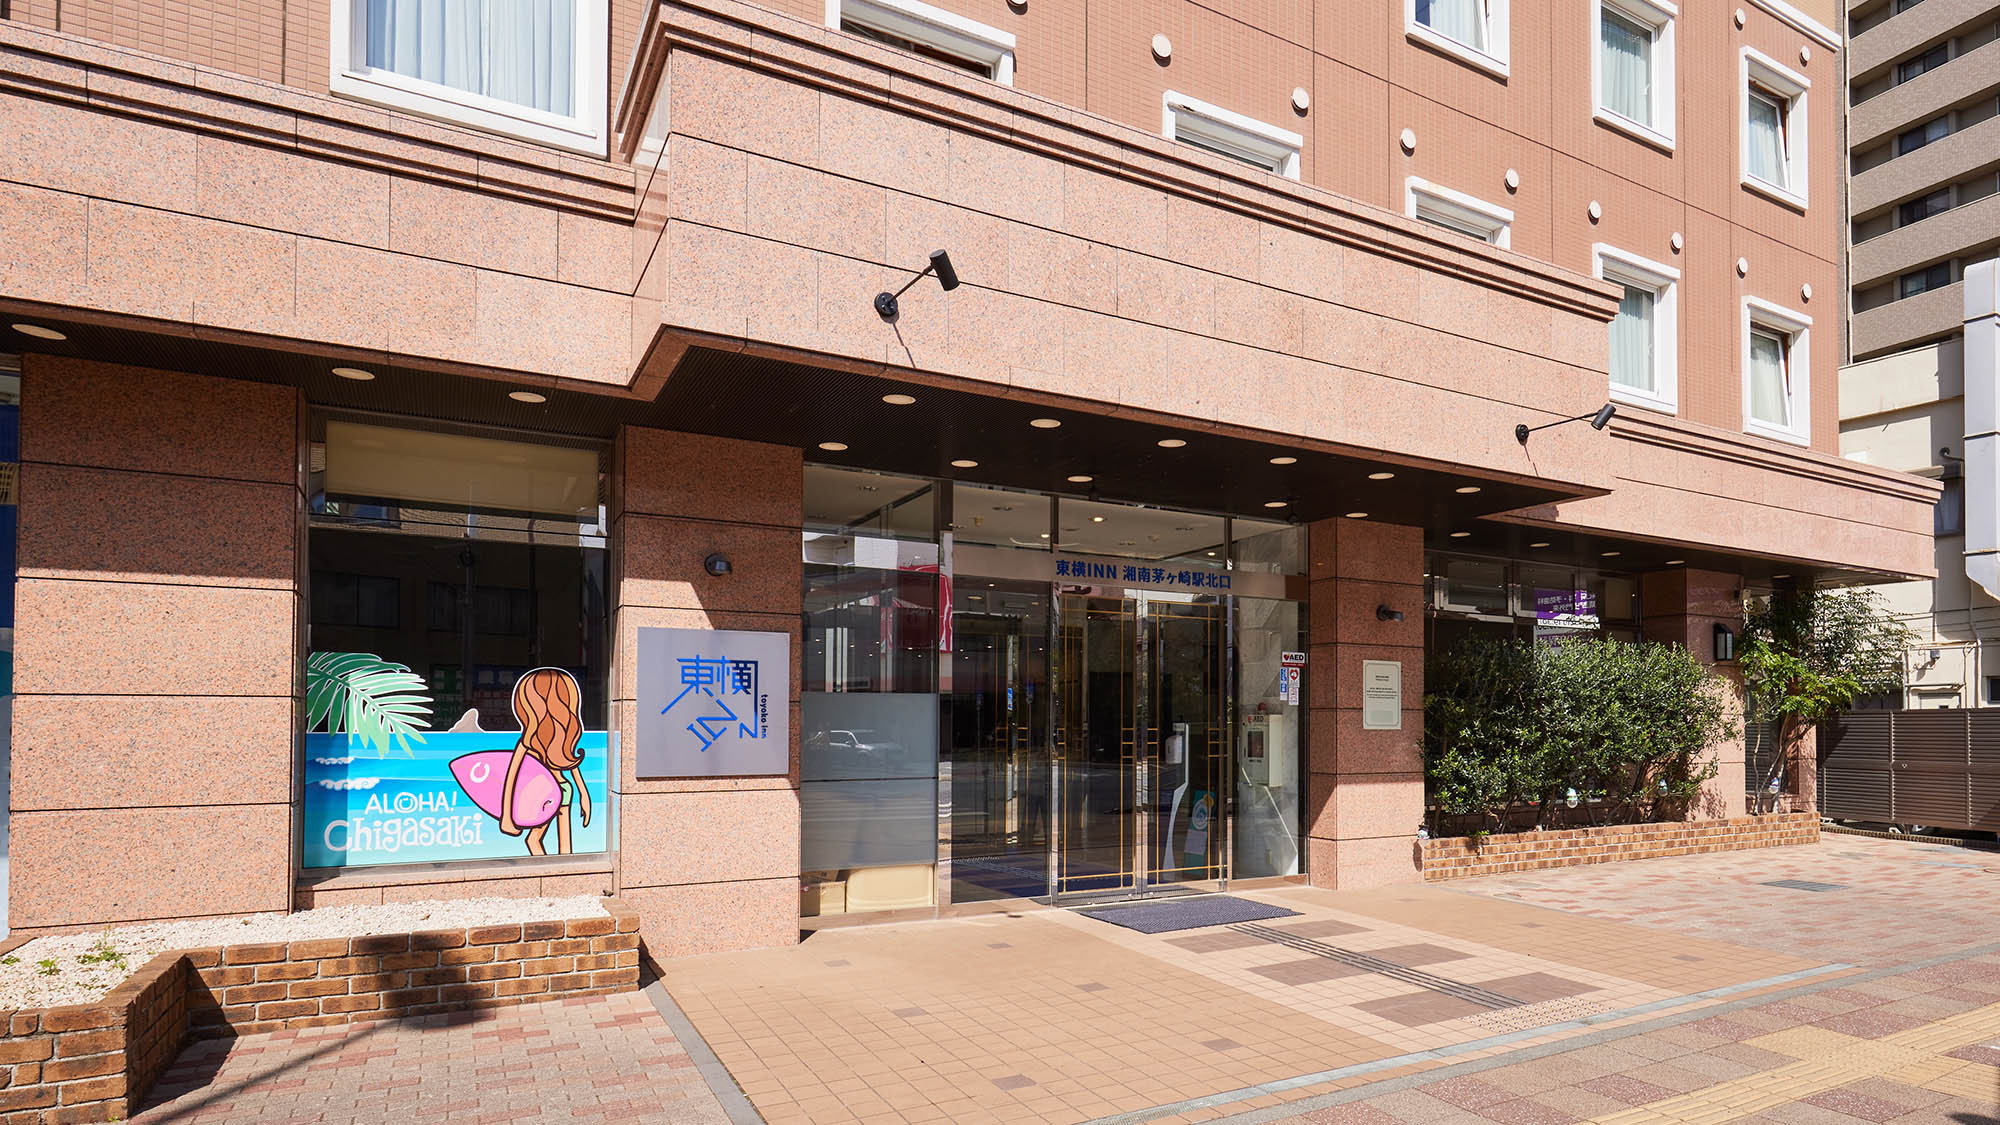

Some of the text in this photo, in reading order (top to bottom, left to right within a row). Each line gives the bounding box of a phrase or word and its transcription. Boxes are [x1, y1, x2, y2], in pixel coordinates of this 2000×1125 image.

[1055, 559, 1118, 579] 東横INN
[760, 694, 768, 739] toyoko inn
[364, 791, 457, 815] ALOHA!
[323, 812, 484, 853] Chigasaki
